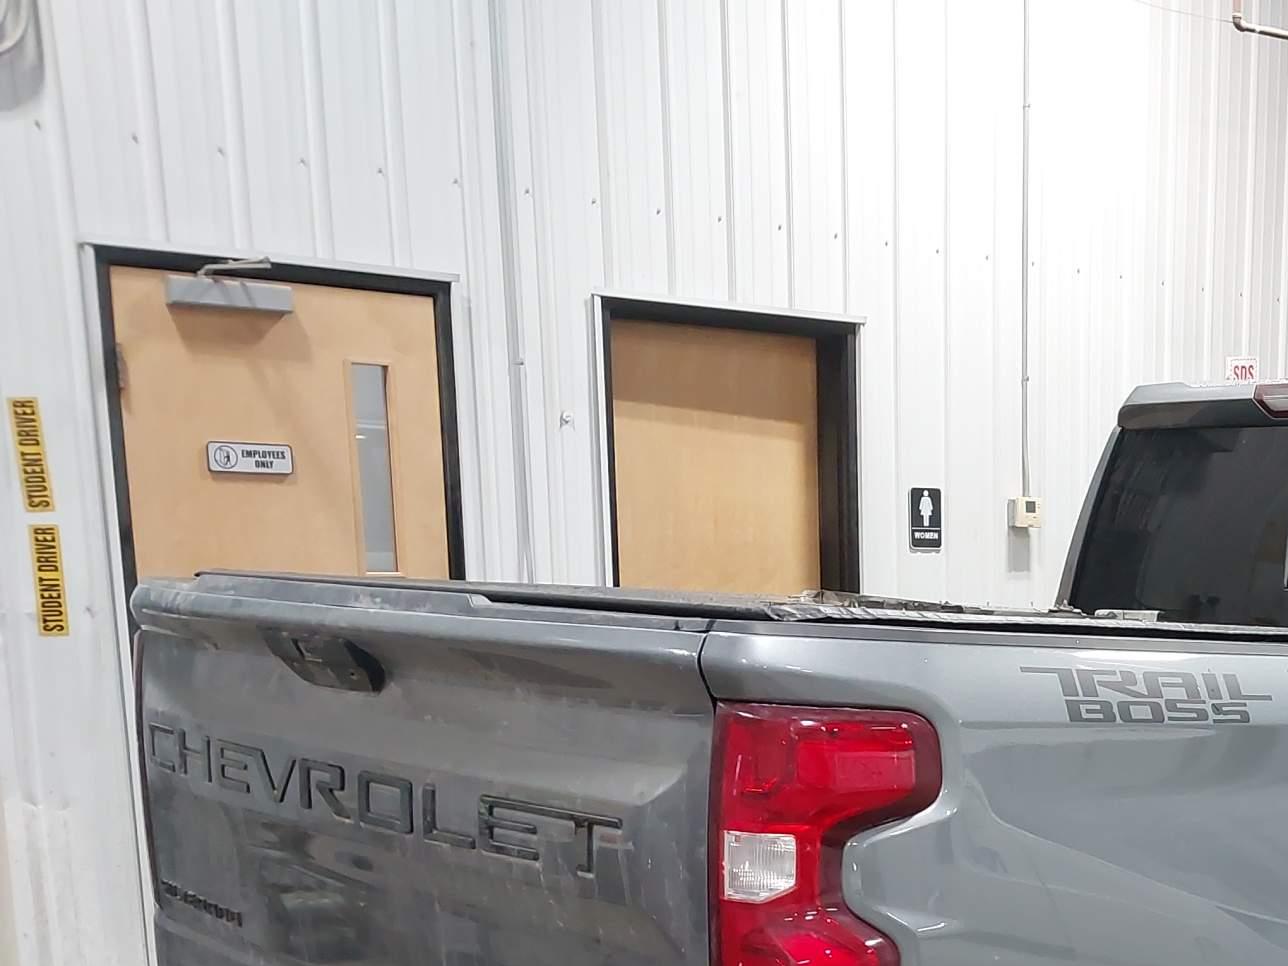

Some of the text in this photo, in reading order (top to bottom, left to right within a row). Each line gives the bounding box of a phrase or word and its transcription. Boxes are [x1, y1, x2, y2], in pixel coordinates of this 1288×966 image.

[12, 399, 51, 508] STUDENT DRIVER
[241, 449, 287, 460] EMPLOYEES
[254, 460, 274, 469] ONLY
[913, 531, 939, 540] WOMEN
[33, 527, 65, 632] STUDENT DRIVER
[1019, 665, 1273, 702] TRAIL
[1065, 699, 1251, 723] BOSS
[148, 721, 624, 879] CHEVROLET
